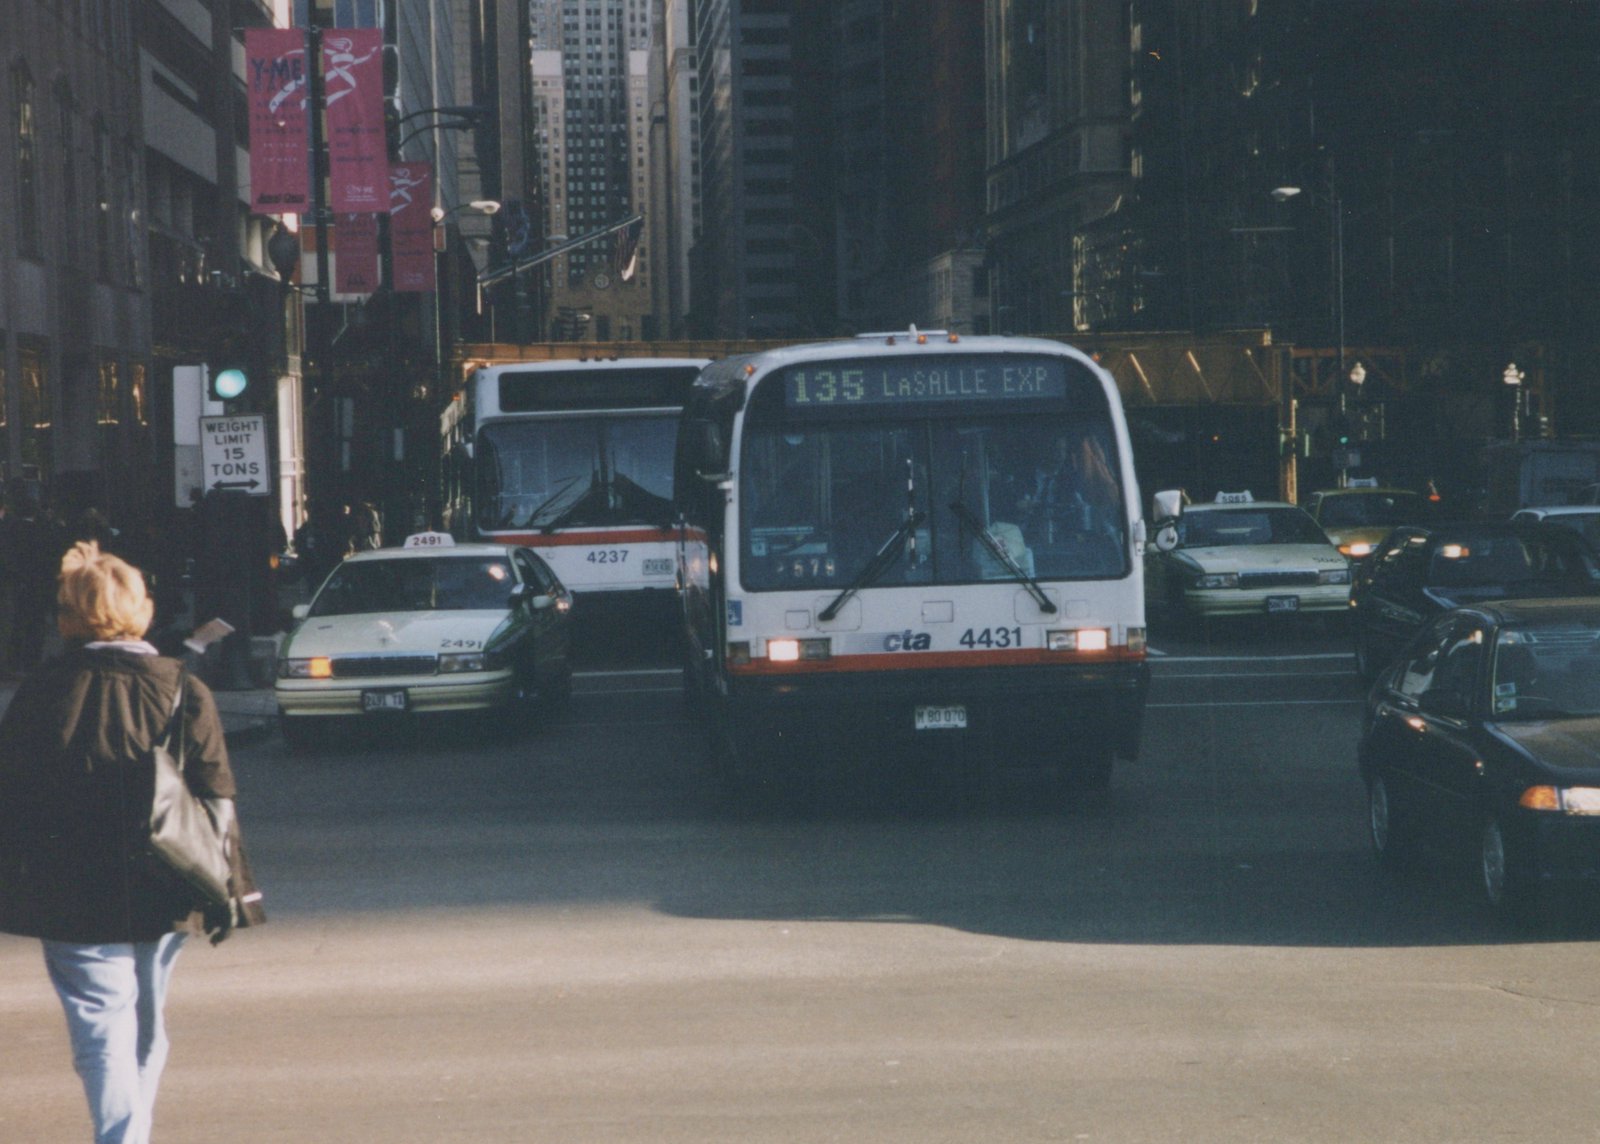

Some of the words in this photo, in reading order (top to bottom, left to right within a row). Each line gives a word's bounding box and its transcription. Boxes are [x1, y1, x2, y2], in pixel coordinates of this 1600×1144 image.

[251, 57, 302, 80] Y-ME
[795, 370, 864, 402] 135
[883, 368, 987, 397] LaSALLE
[1003, 366, 1047, 392] EXP
[205, 420, 259, 433] WEIGHT
[214, 433, 252, 445] LIMIT
[223, 447, 245, 460] 15
[211, 461, 260, 476] TONS
[413, 536, 442, 546] 2491
[587, 549, 629, 564] 4237
[440, 638, 482, 650] 2491
[883, 629, 932, 651] cta
[959, 626, 1022, 649] 4431
